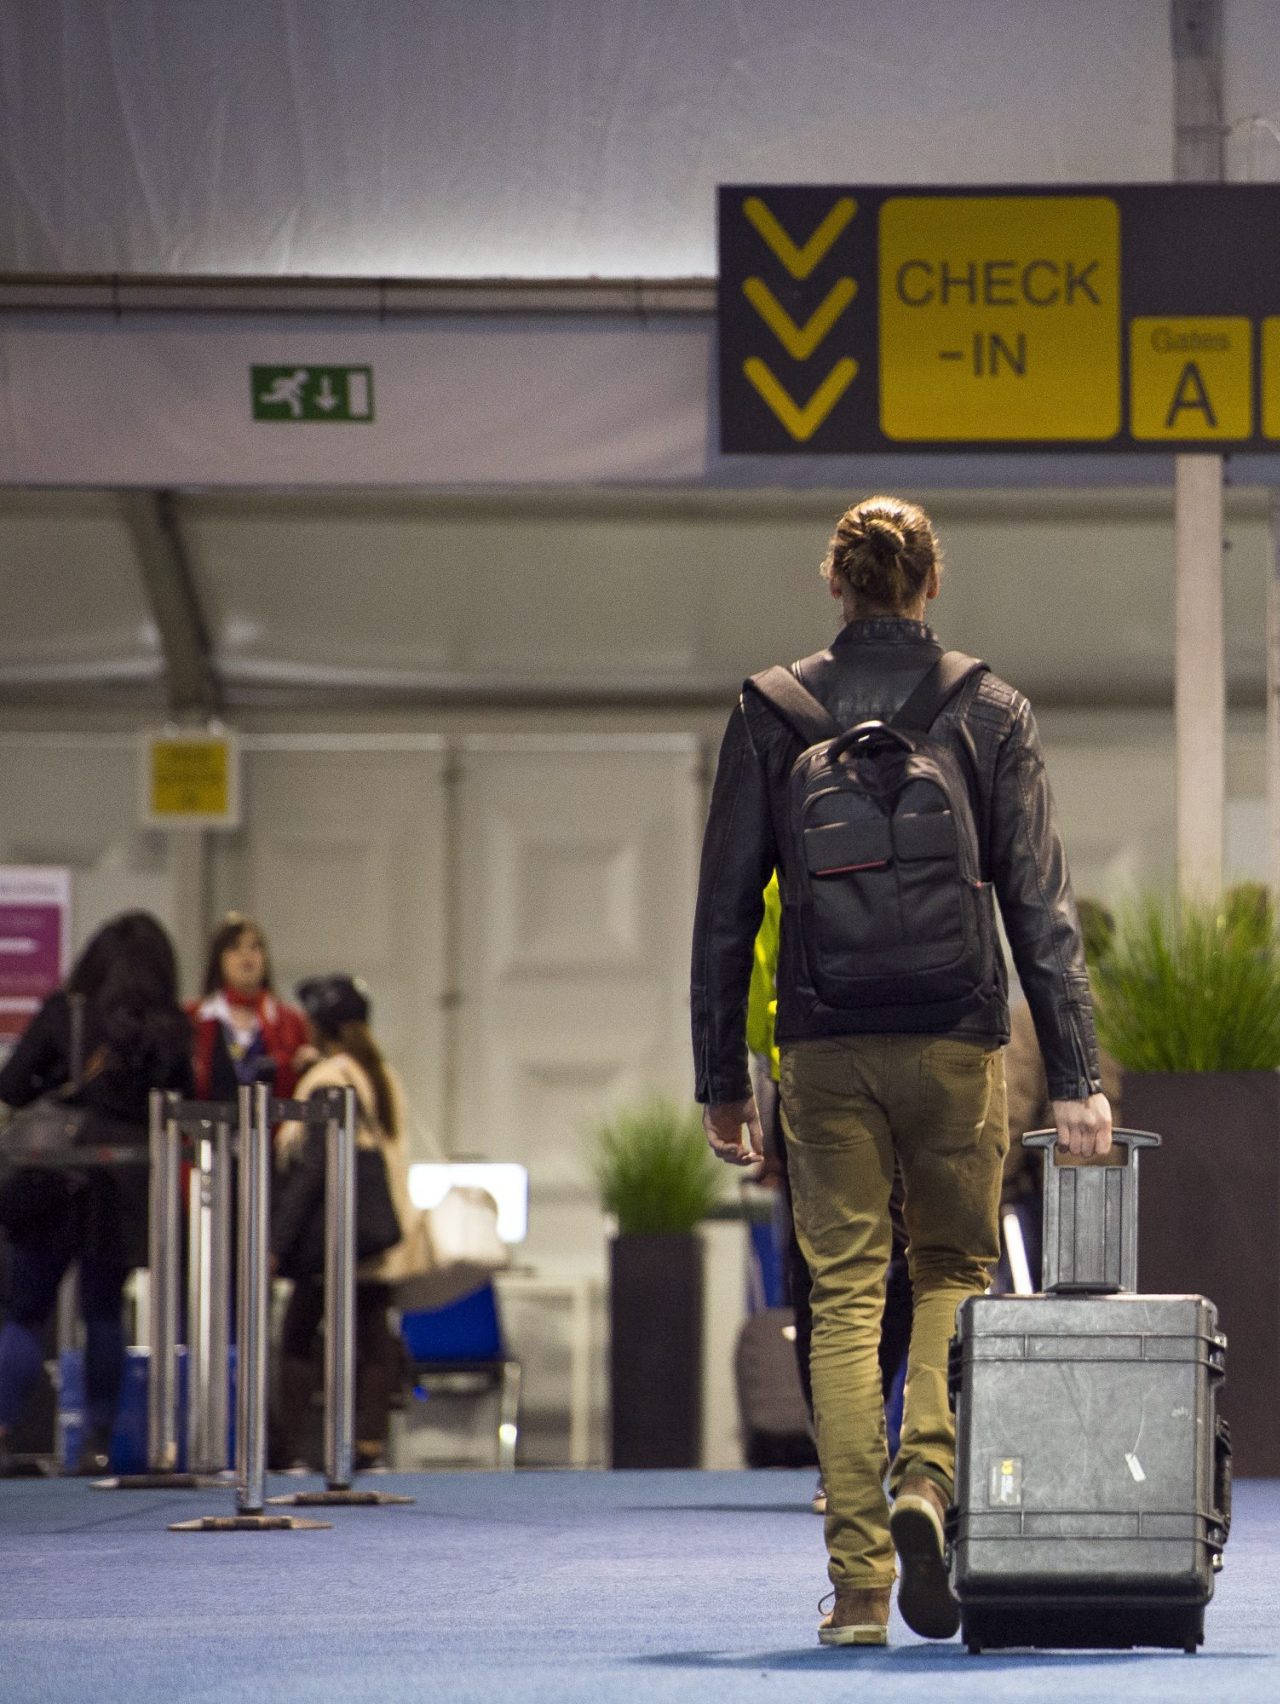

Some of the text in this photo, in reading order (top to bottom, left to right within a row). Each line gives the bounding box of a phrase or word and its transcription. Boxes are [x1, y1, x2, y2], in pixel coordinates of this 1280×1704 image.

[895, 259, 1103, 308] CHECK
[938, 331, 1028, 378] -IN
[1150, 327, 1231, 353] Gates
[1164, 360, 1219, 430] A
